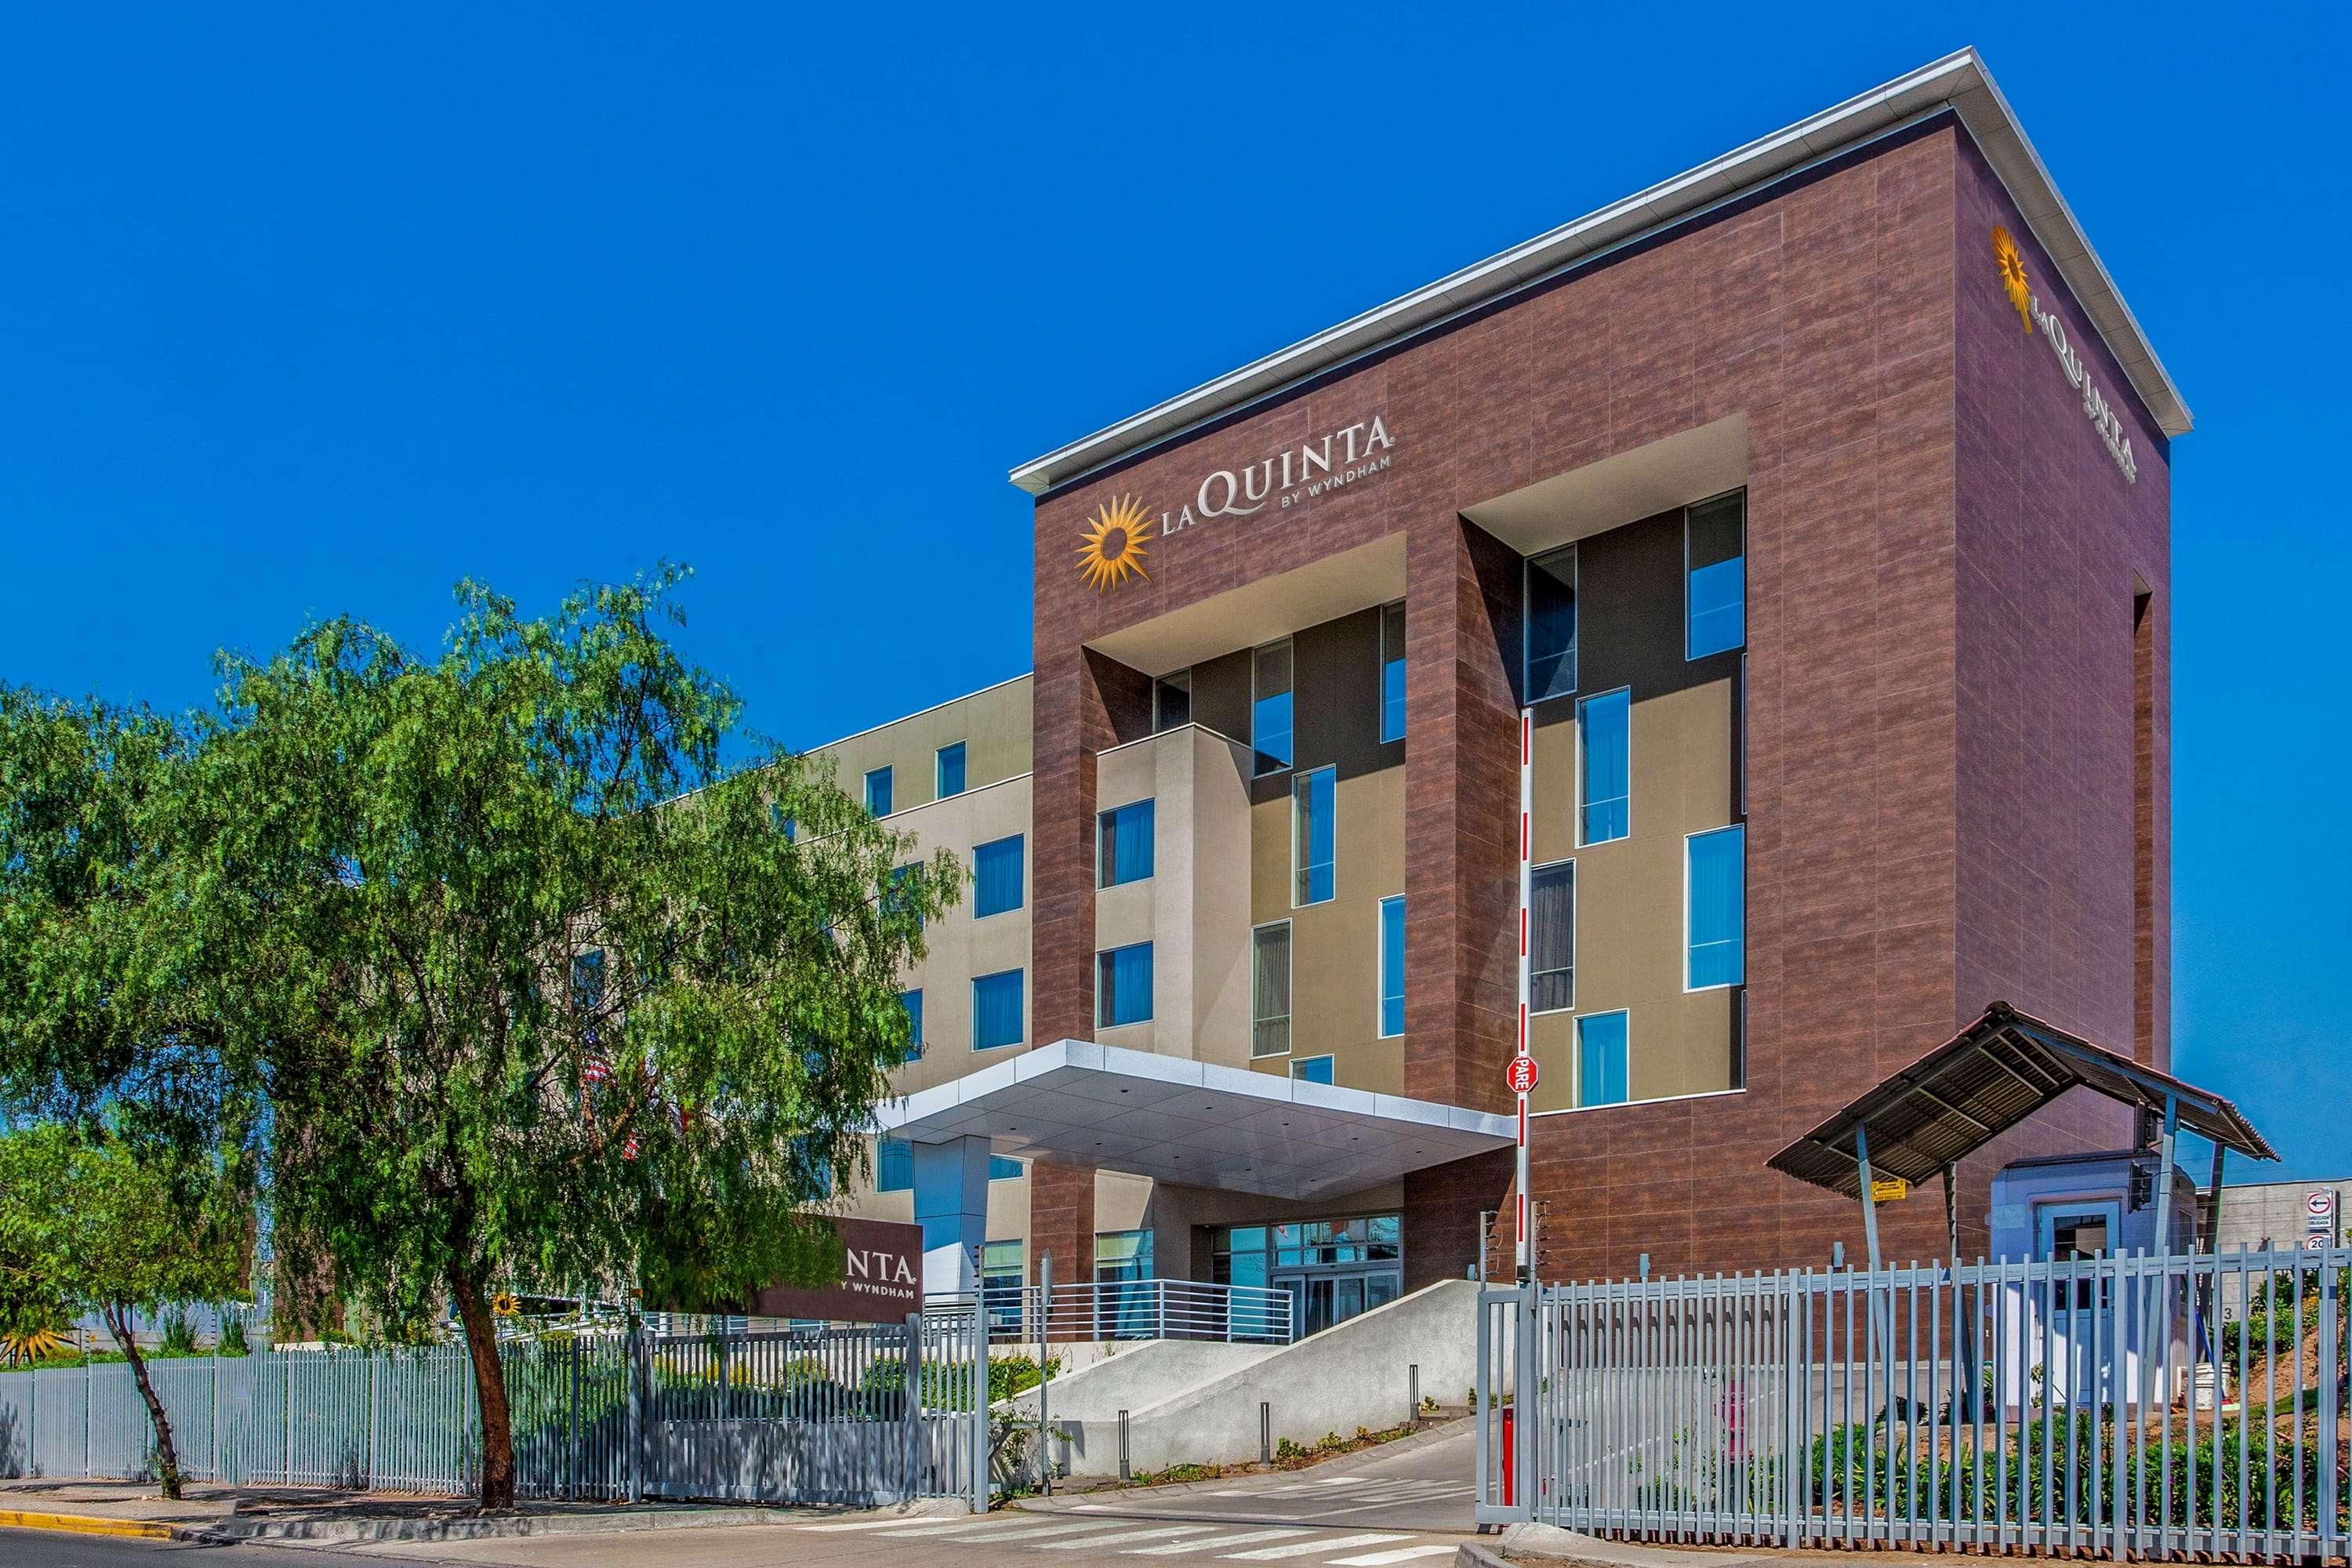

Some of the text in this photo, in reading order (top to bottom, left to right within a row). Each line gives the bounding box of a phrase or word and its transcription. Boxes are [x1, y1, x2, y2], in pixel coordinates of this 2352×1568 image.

[2048, 314, 2138, 474] QUINTA
[1161, 415, 1395, 537] LA QUINTA
[1281, 455, 1392, 509] BY WYNDHAM
[1515, 1058, 1530, 1090] PARE
[2311, 1240, 2324, 1248] 20
[846, 1247, 916, 1285] NTA
[840, 1280, 914, 1299] Y WYNDHAM
